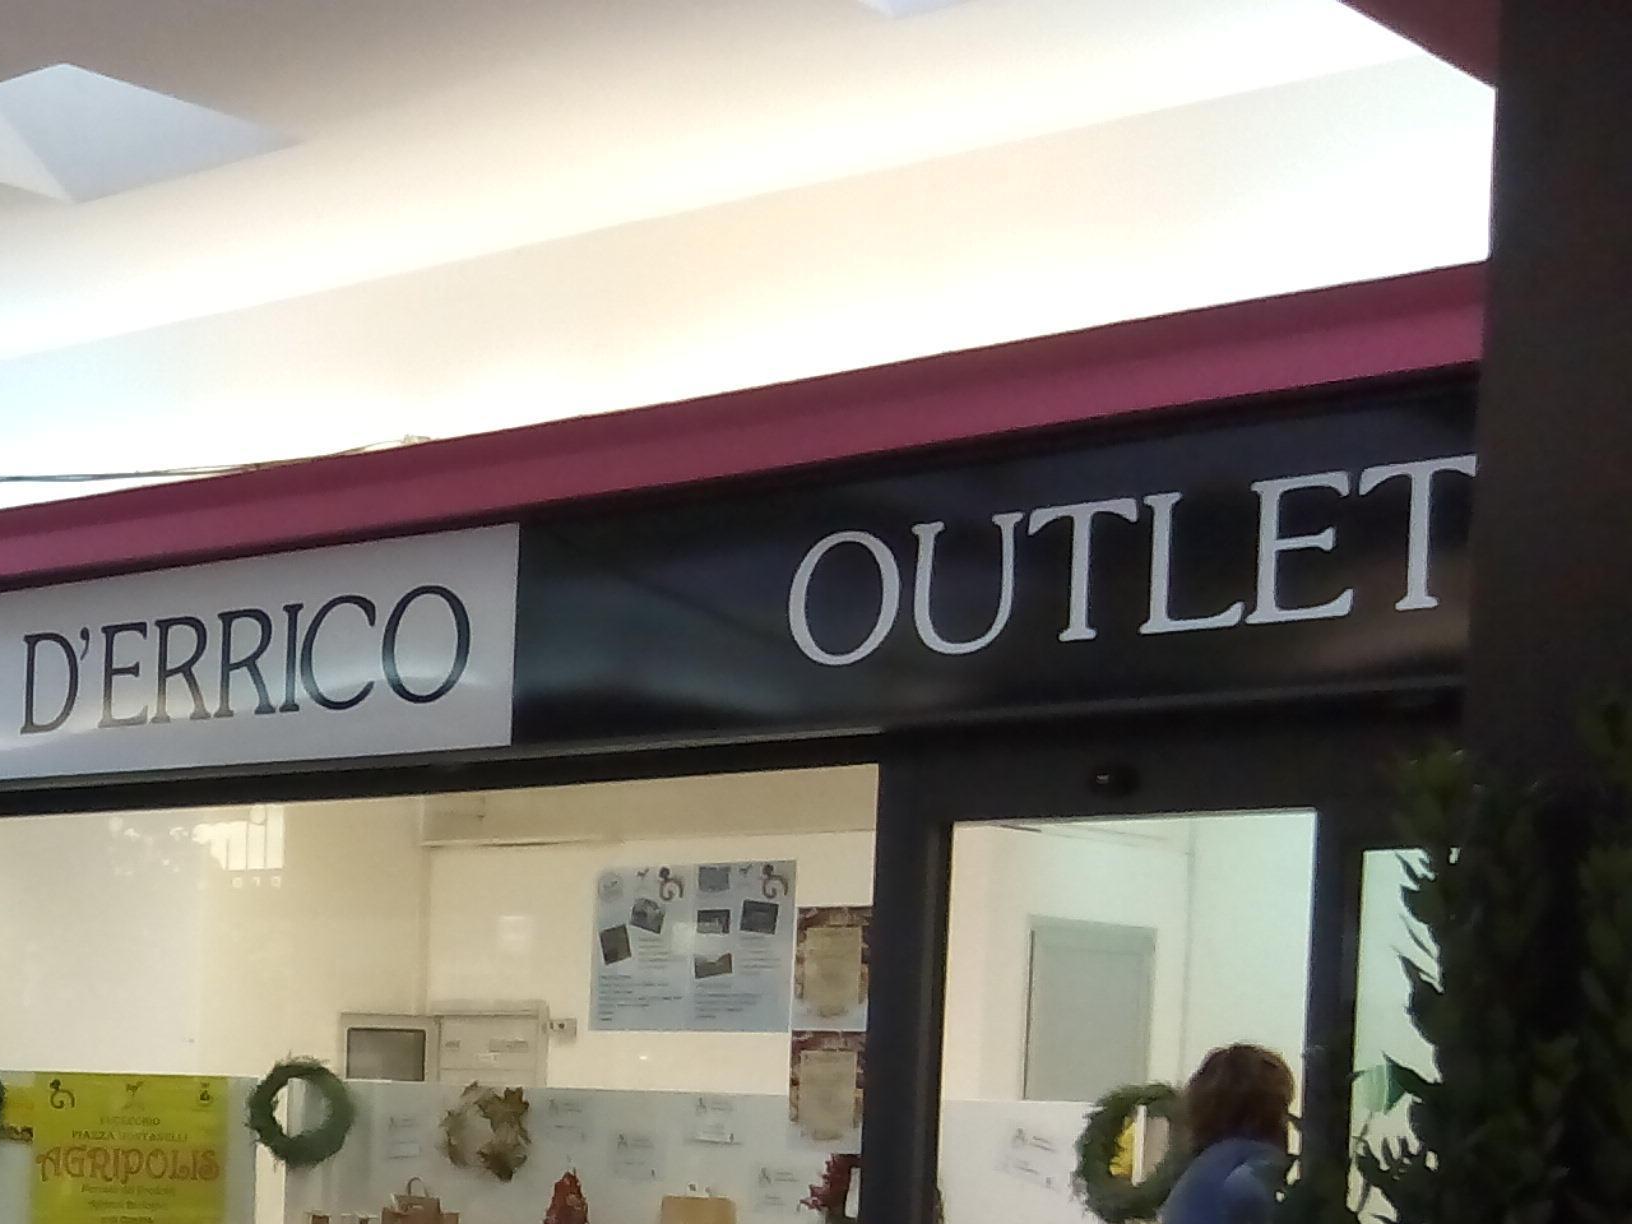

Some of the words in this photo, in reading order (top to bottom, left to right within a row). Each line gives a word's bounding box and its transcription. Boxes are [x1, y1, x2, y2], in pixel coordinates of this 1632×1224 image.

[788, 453, 1478, 666] OUTLET
[19, 584, 471, 735] D'ERRICO
[36, 1144, 221, 1184] AGRIPOLIS
